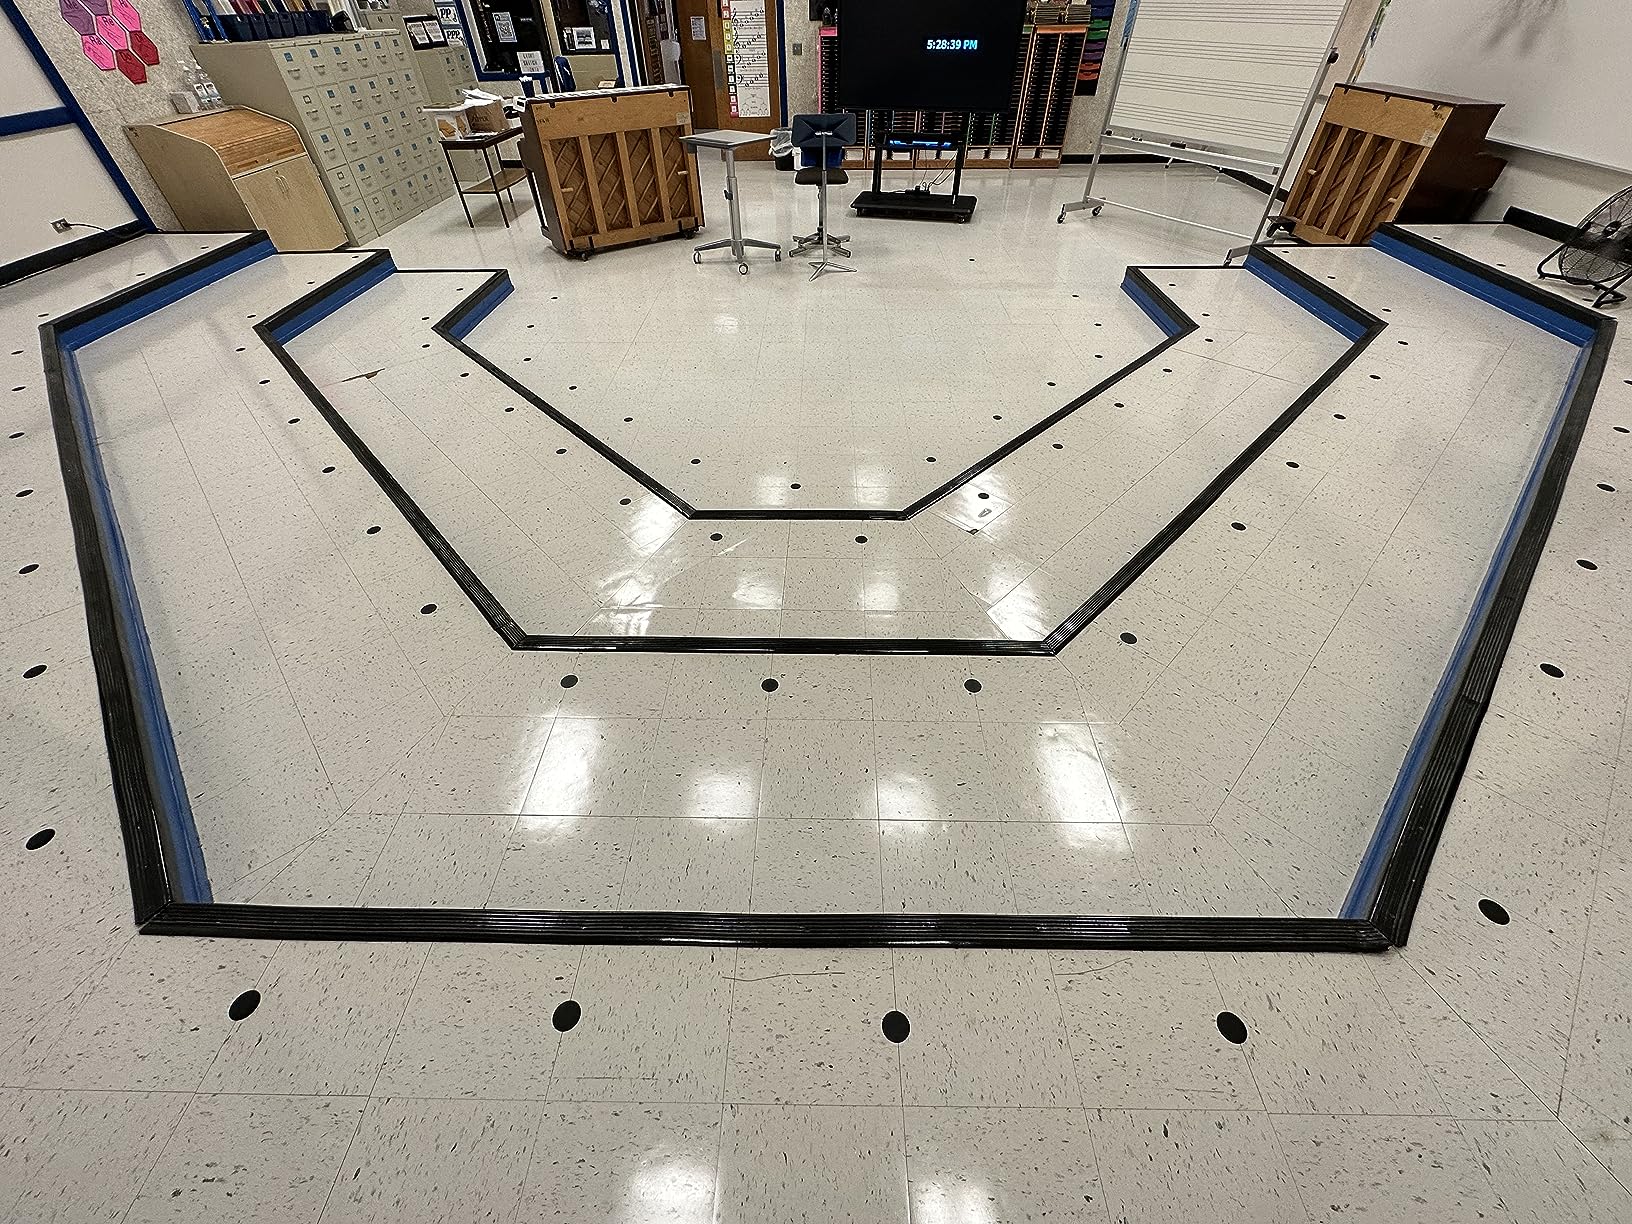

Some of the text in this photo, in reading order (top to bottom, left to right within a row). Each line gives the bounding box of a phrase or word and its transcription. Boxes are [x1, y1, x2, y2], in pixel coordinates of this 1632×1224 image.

[102, 16, 115, 26] Re
[89, 36, 102, 46] Ra
[926, 39, 978, 50] 5:28:39 PM
